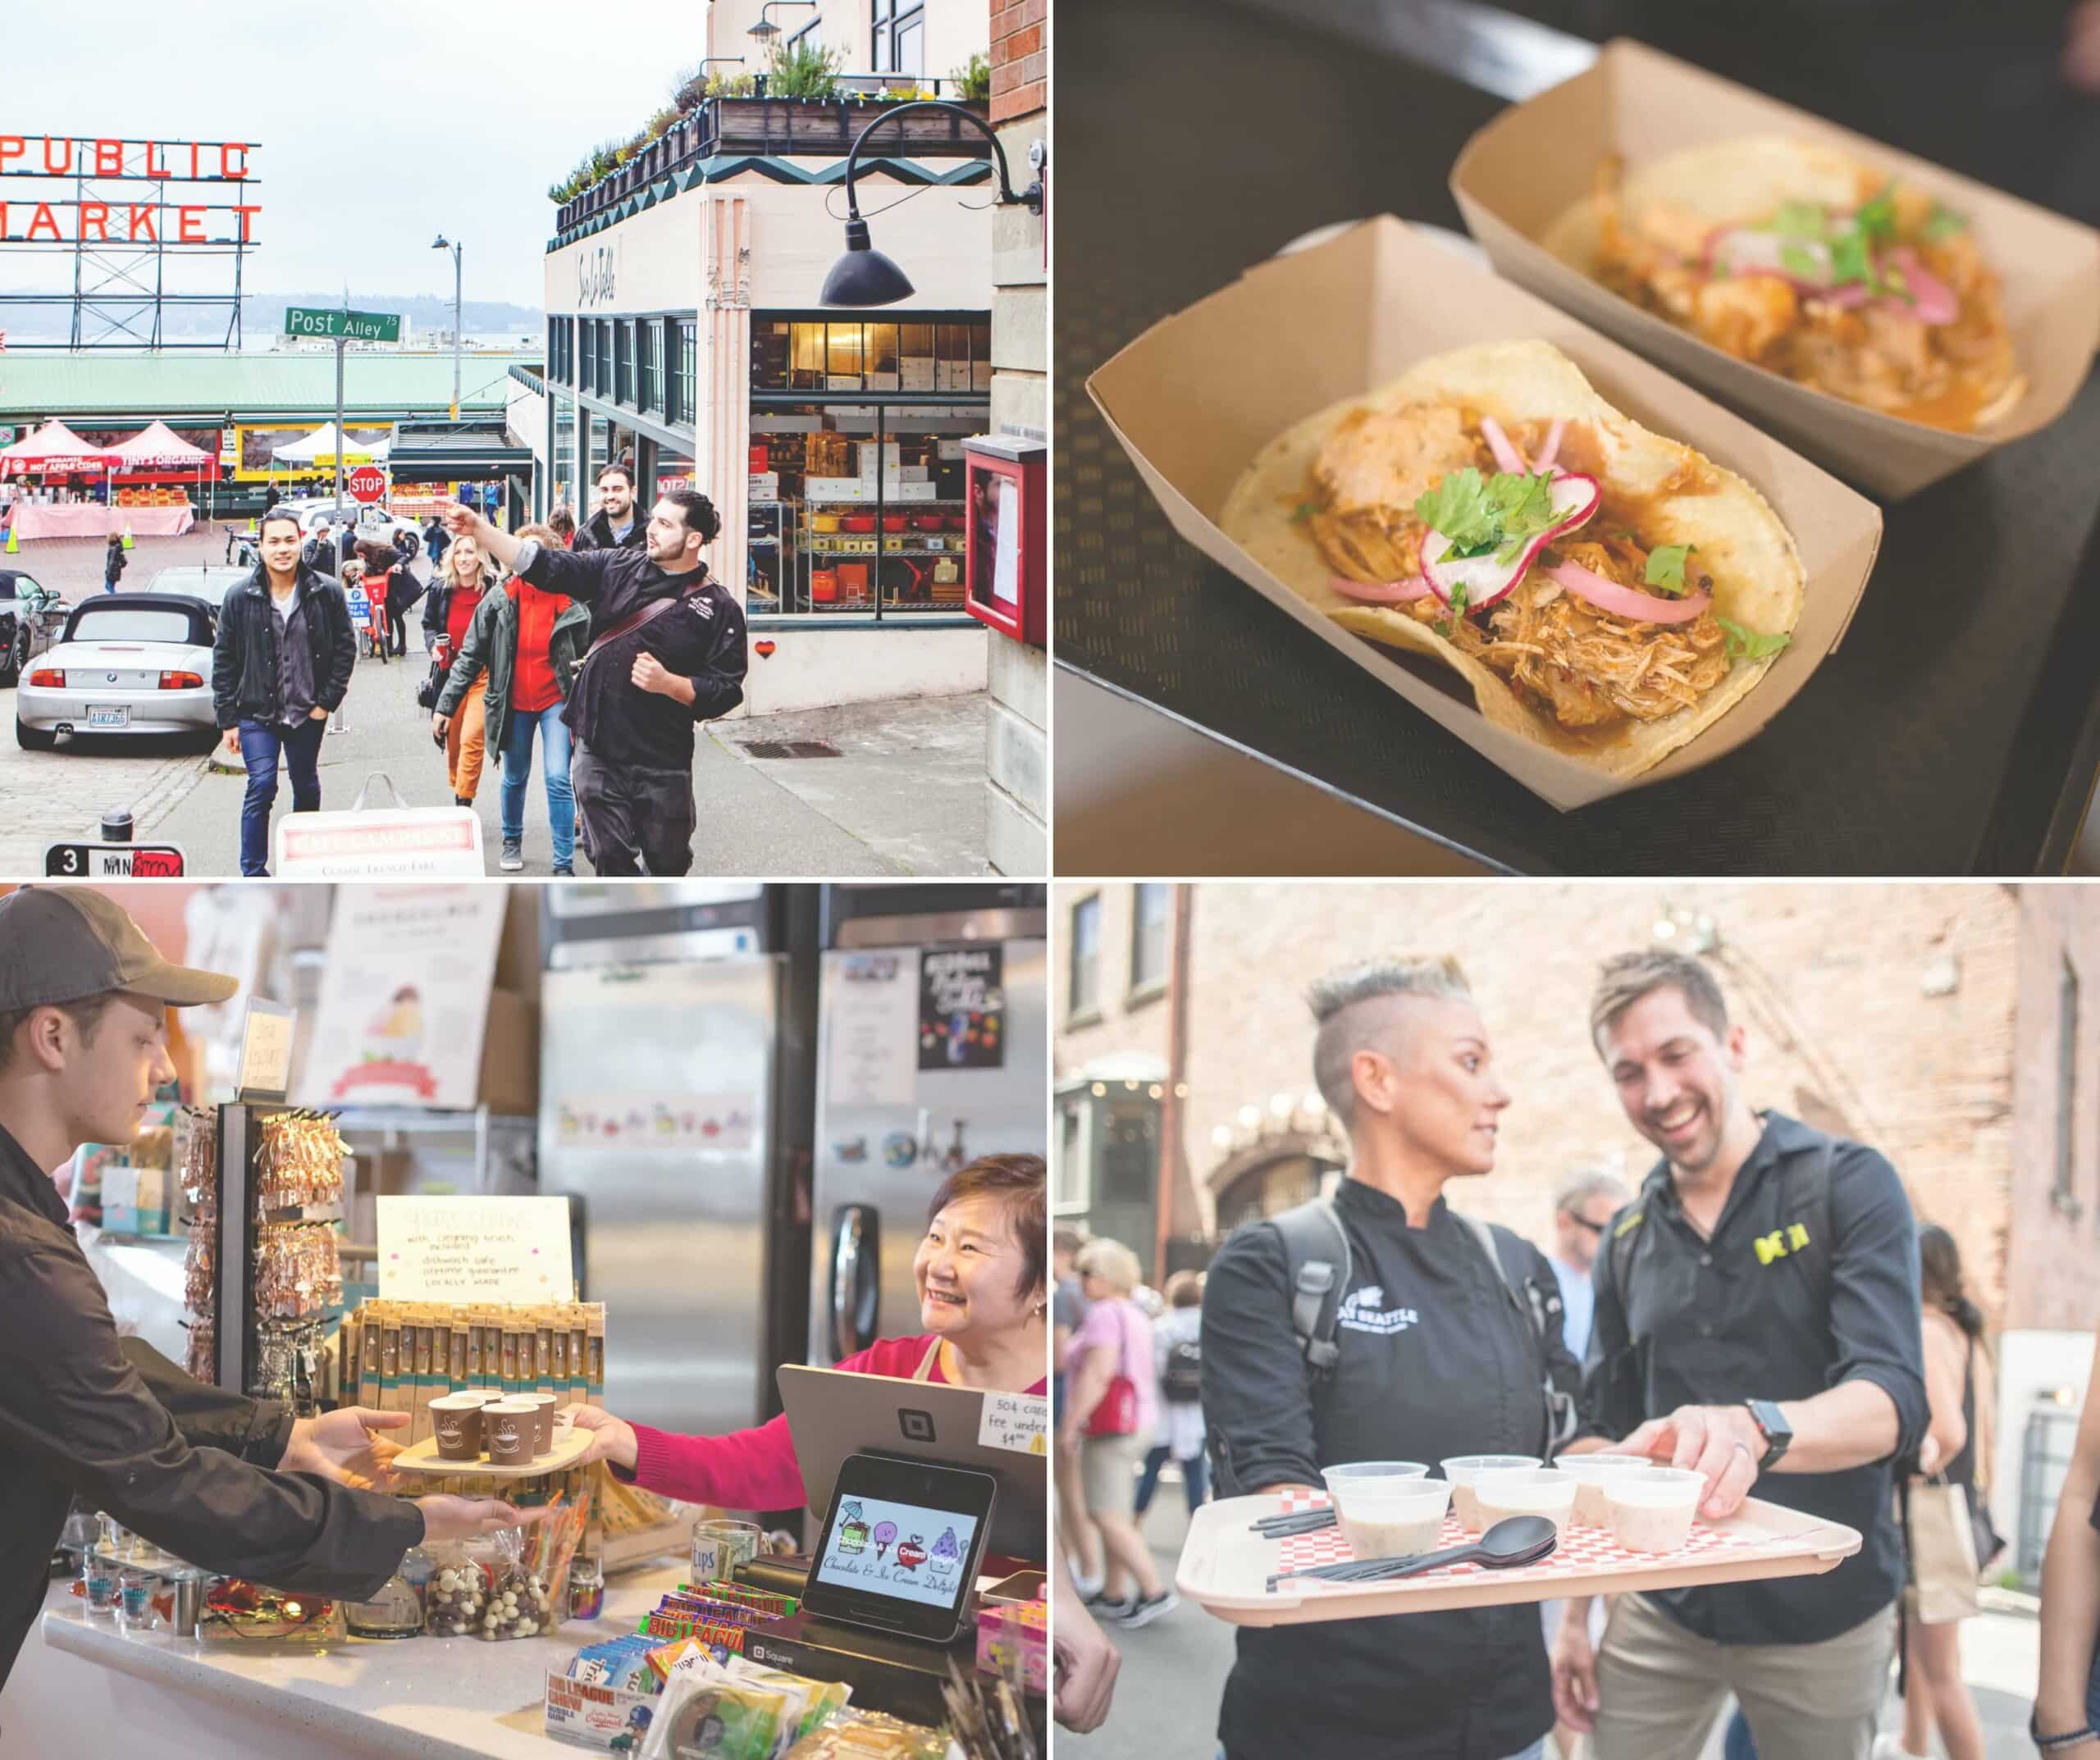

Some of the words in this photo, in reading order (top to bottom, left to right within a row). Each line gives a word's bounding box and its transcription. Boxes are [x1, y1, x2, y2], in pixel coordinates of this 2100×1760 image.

[0, 136, 249, 179] PUBLIC
[0, 202, 262, 243] ARKET
[291, 311, 334, 333] Post
[343, 320, 381, 339] Alley
[386, 316, 397, 326] 75
[30, 463, 47, 472] HOT
[48, 462, 75, 471] APPLE
[77, 461, 103, 469] CIDER
[122, 455, 153, 465] TINY'S
[156, 454, 206, 465] ORGANIC
[351, 478, 383, 492] STOP
[62, 849, 78, 873] 3
[693, 1548, 715, 1574] tips
[899, 1546, 927, 1559] Cream
[824, 1554, 860, 1575] Chocolate
[892, 1568, 920, 1587] Cream
[648, 1616, 678, 1639] BIG
[765, 1649, 795, 1665] Square
[547, 1689, 583, 1713] CHEW
[566, 1680, 615, 1707] LEAGUE
[547, 1703, 575, 1719] BUBBLE
[547, 1712, 565, 1724] GUM
